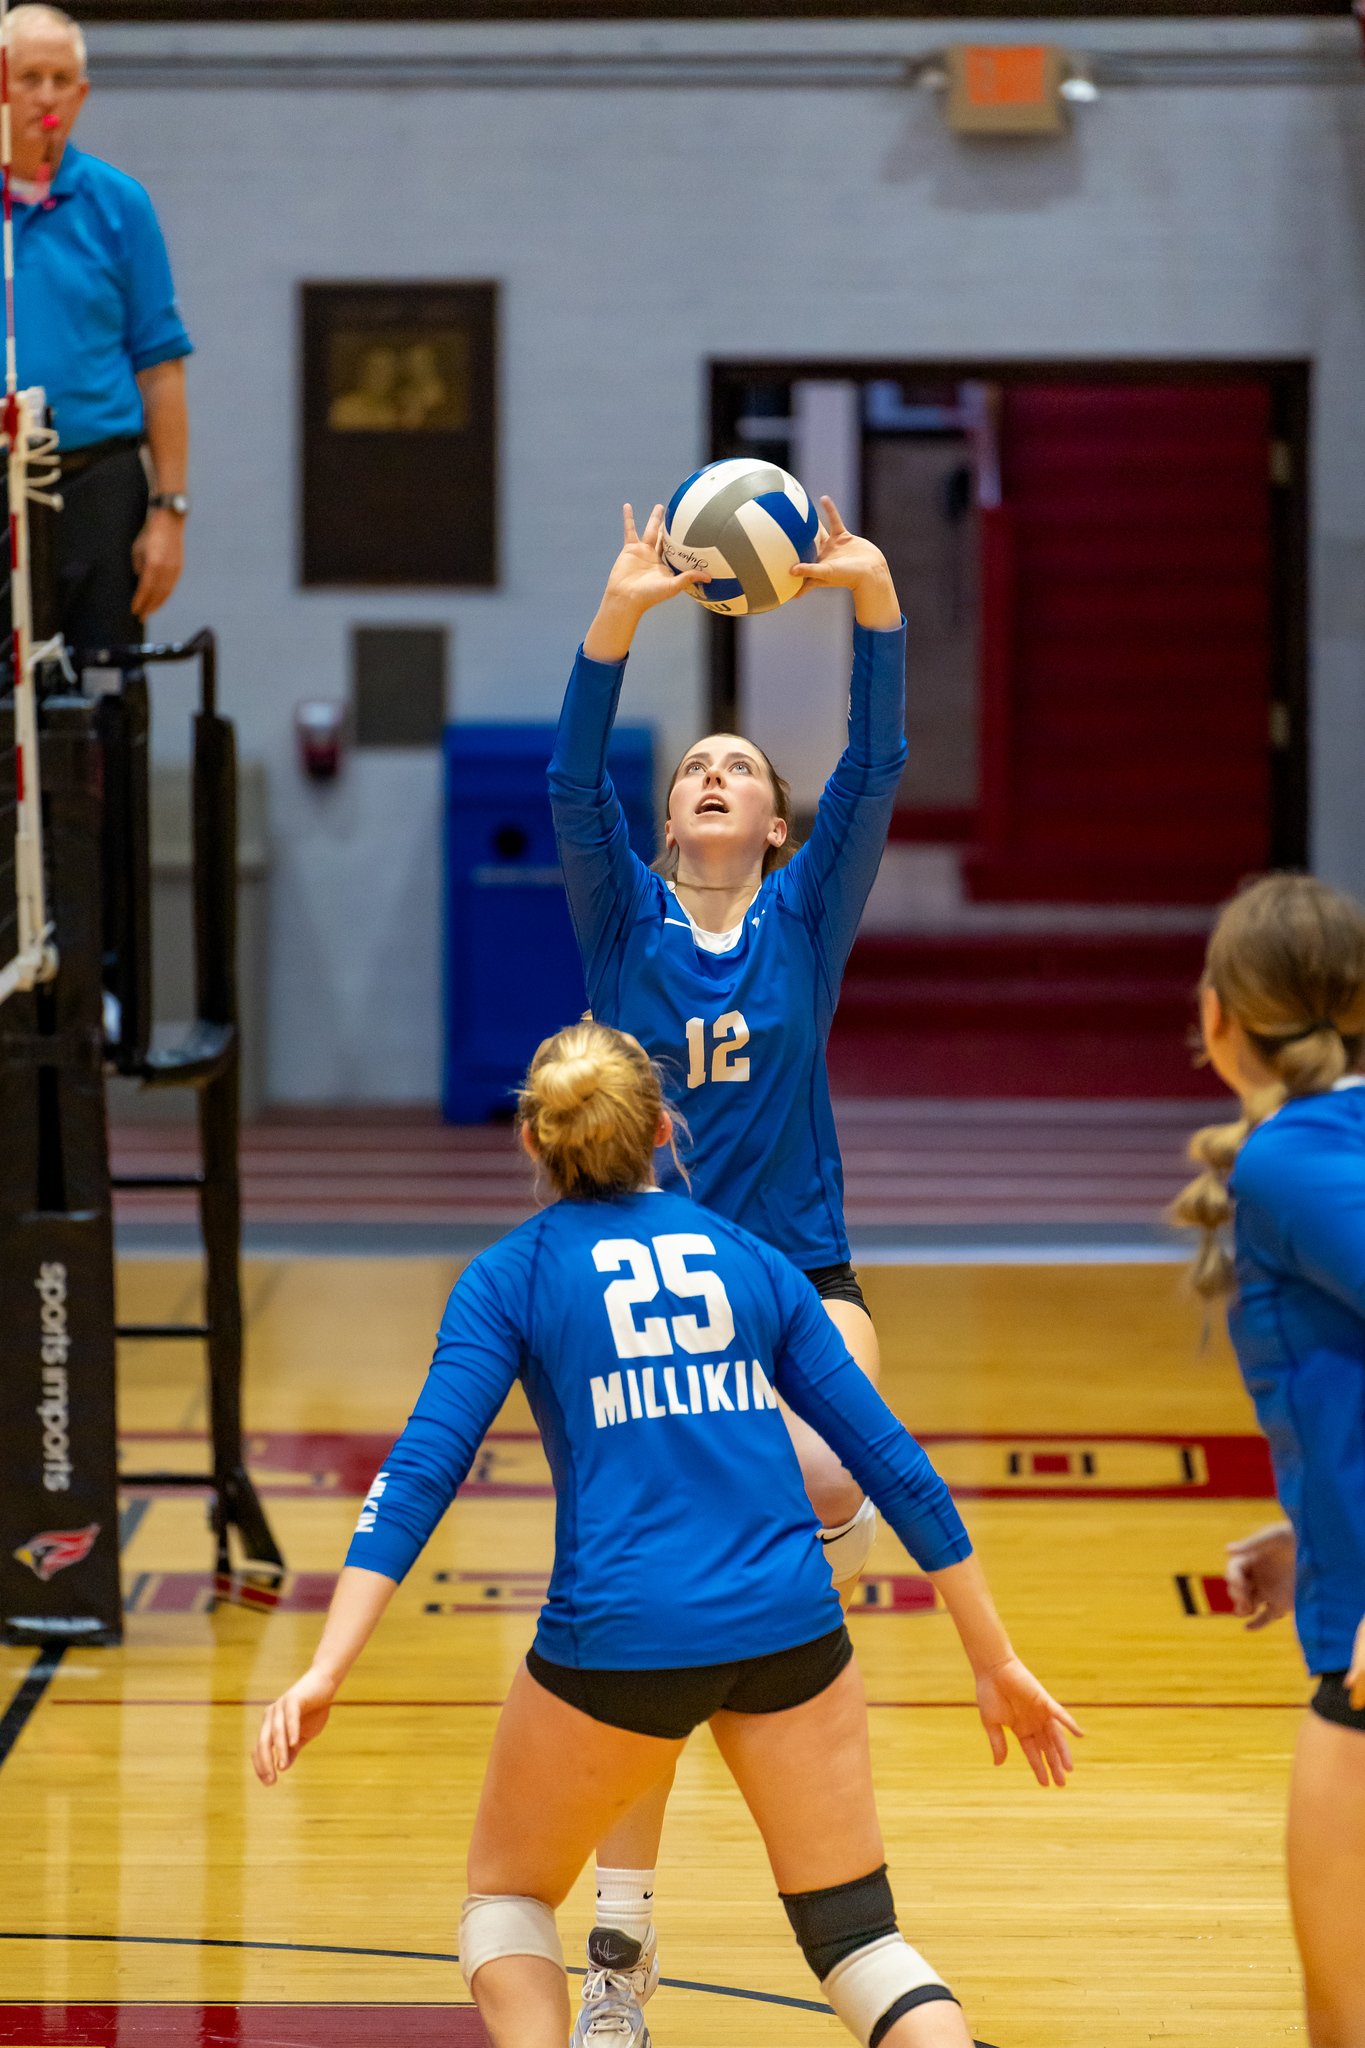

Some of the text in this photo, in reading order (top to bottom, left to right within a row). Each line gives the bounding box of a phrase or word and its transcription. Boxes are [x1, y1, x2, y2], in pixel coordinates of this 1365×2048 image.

[686, 1010, 750, 1089] 12
[35, 1261, 72, 1364] sports
[591, 1233, 735, 1359] 25
[590, 1359, 777, 1429] MILLIKIN
